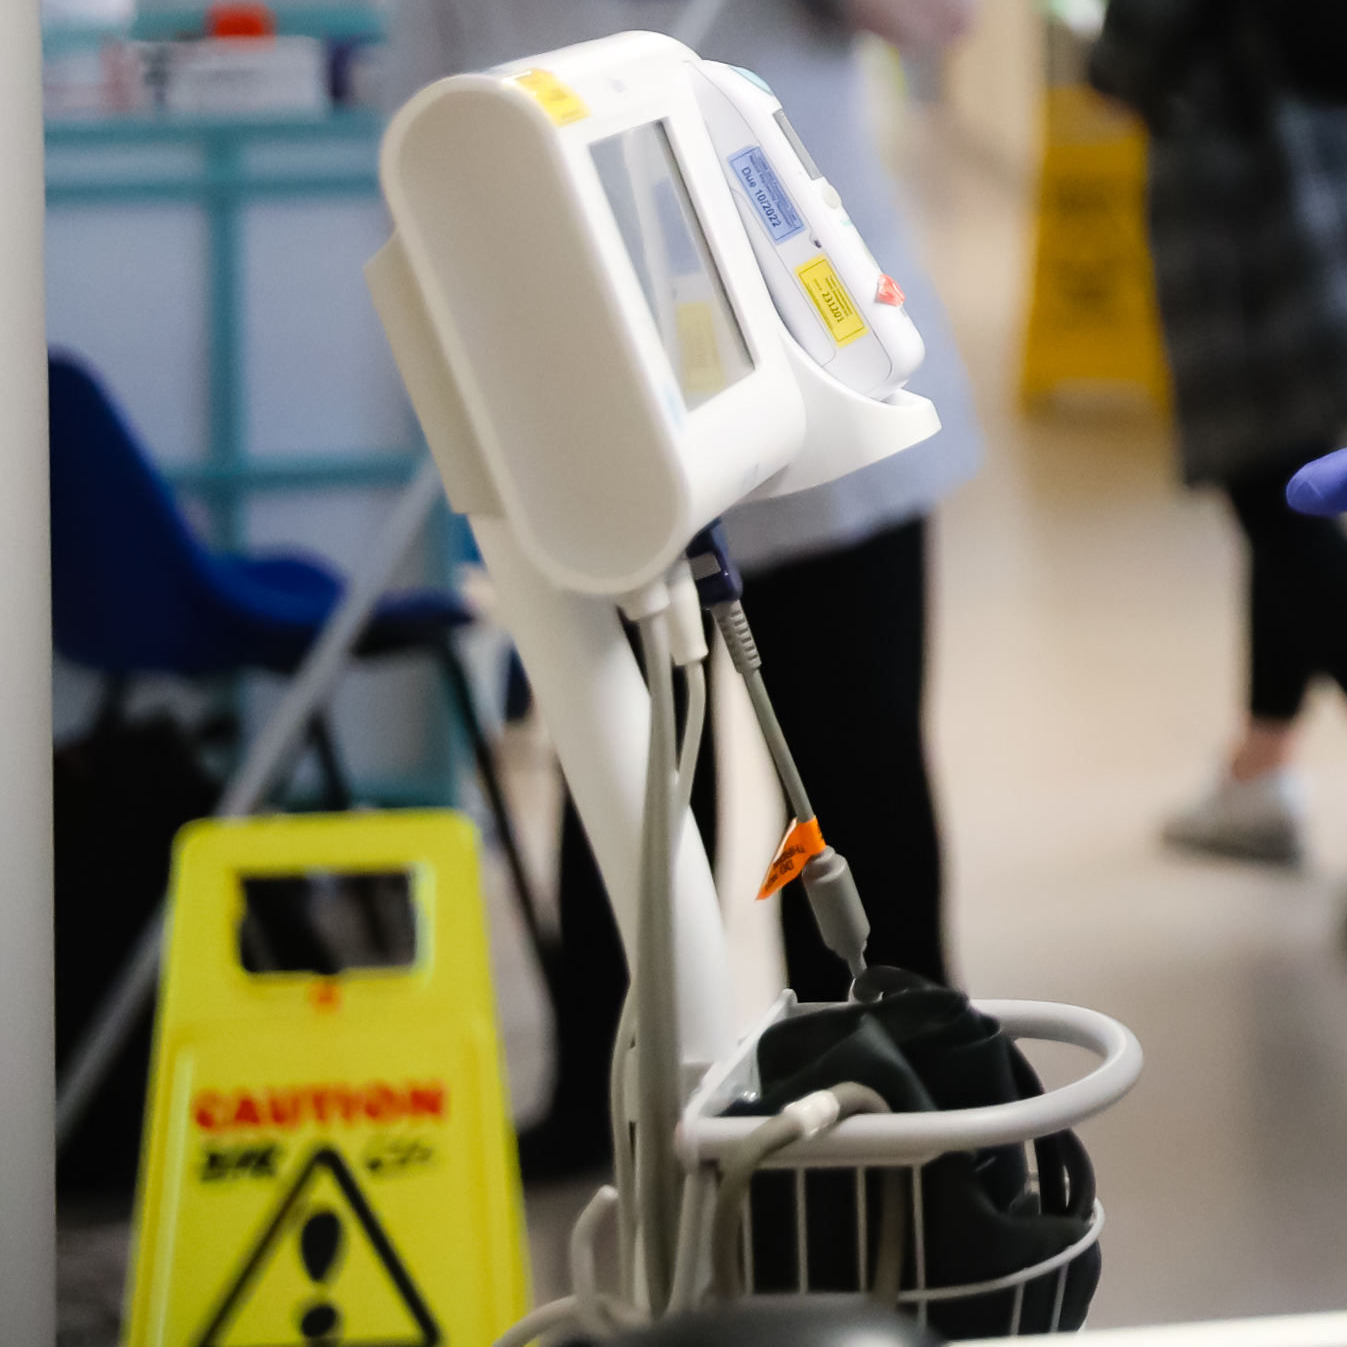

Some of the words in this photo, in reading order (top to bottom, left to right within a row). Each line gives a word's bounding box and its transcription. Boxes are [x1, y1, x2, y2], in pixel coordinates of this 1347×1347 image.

[741, 166, 757, 188] Due
[755, 189, 782, 228] 10/2022
[821, 291, 845, 323] 231201
[193, 1081, 448, 1132] CAUTION
